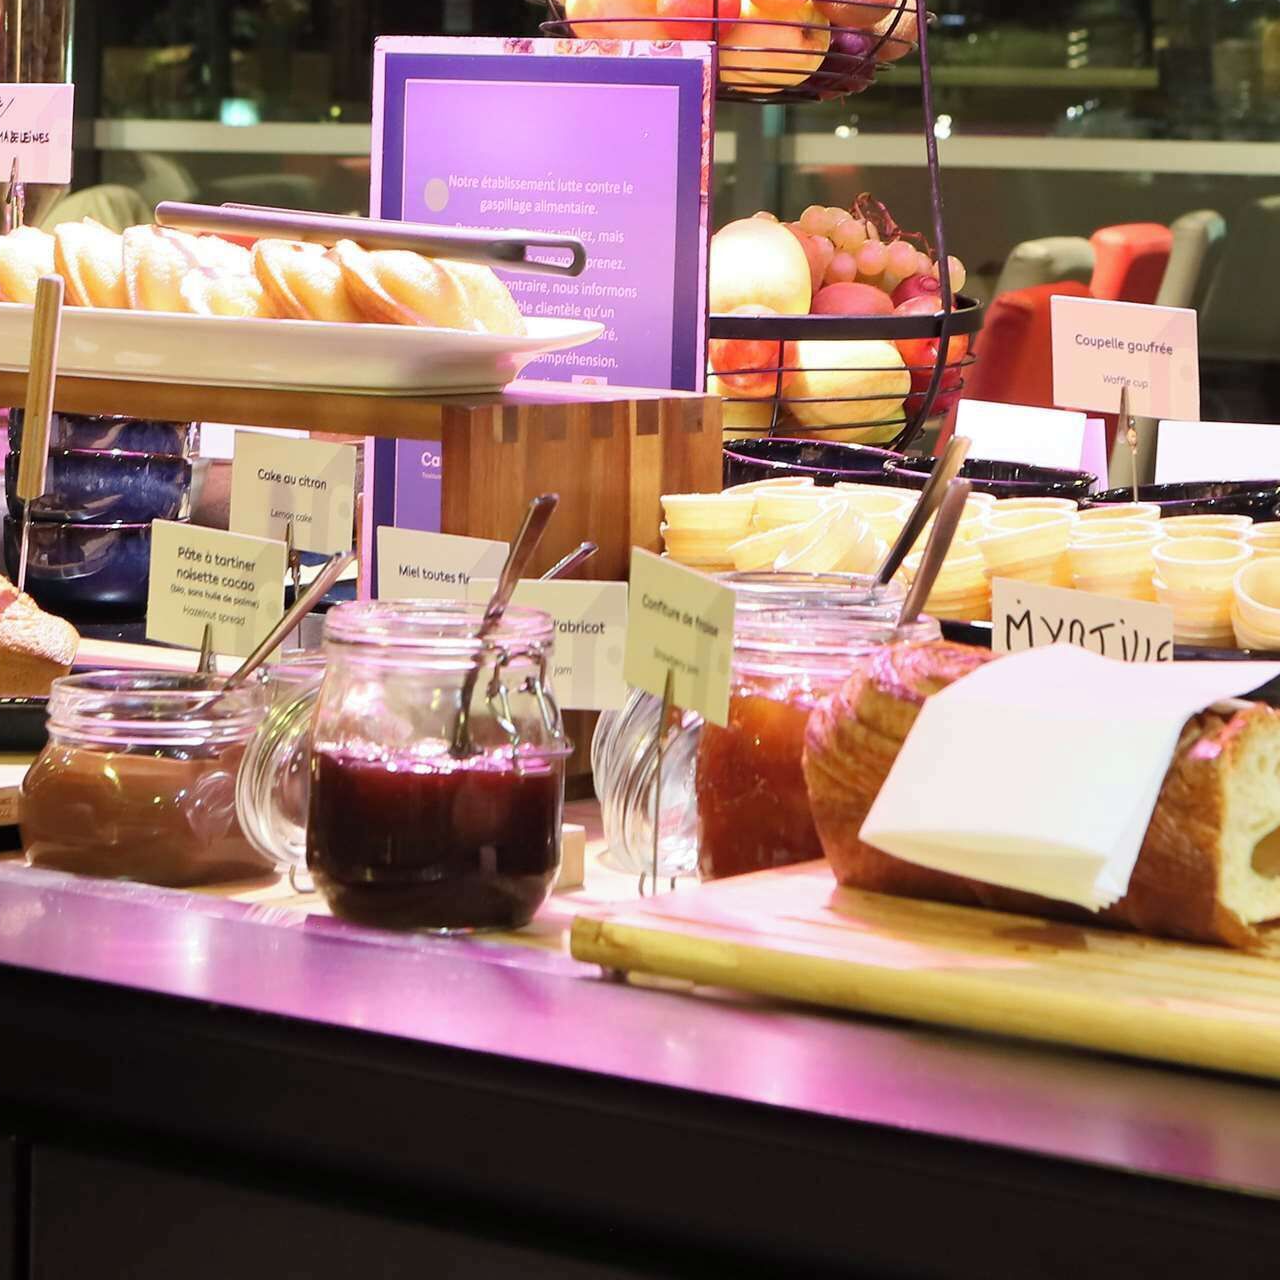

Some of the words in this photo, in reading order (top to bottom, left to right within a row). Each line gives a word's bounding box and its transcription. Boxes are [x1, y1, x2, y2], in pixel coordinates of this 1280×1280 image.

[448, 174, 480, 188] Notre
[481, 176, 556, 192] établissement
[556, 178, 584, 193] lutte
[585, 180, 621, 194] contre
[622, 181, 634, 194] le
[479, 197, 533, 215] gaspillage
[534, 200, 599, 215] alimentaire.
[597, 229, 625, 242] mais
[586, 256, 626, 271] prenez.
[552, 283, 580, 295] nous
[581, 282, 638, 298] informons
[535, 302, 581, 316] clientèle
[583, 305, 615, 319] qu'un
[1074, 333, 1125, 350] Coupelle
[1127, 341, 1174, 356] gaufrée
[1102, 374, 1131, 387] Waffle
[1132, 378, 1149, 390] cup
[257, 468, 282, 484] Cake
[283, 474, 297, 485] au
[298, 474, 327, 490] citron
[270, 508, 295, 520] Lemon
[177, 546, 202, 562] Pâte
[204, 550, 213, 564] à
[214, 553, 256, 572] tartiner
[176, 567, 219, 585] noisette
[221, 576, 255, 592] cacao
[398, 564, 420, 578] Miel
[422, 568, 456, 583] toutes
[641, 593, 680, 623] Confiture
[682, 613, 693, 627] de
[554, 664, 573, 677] jam
